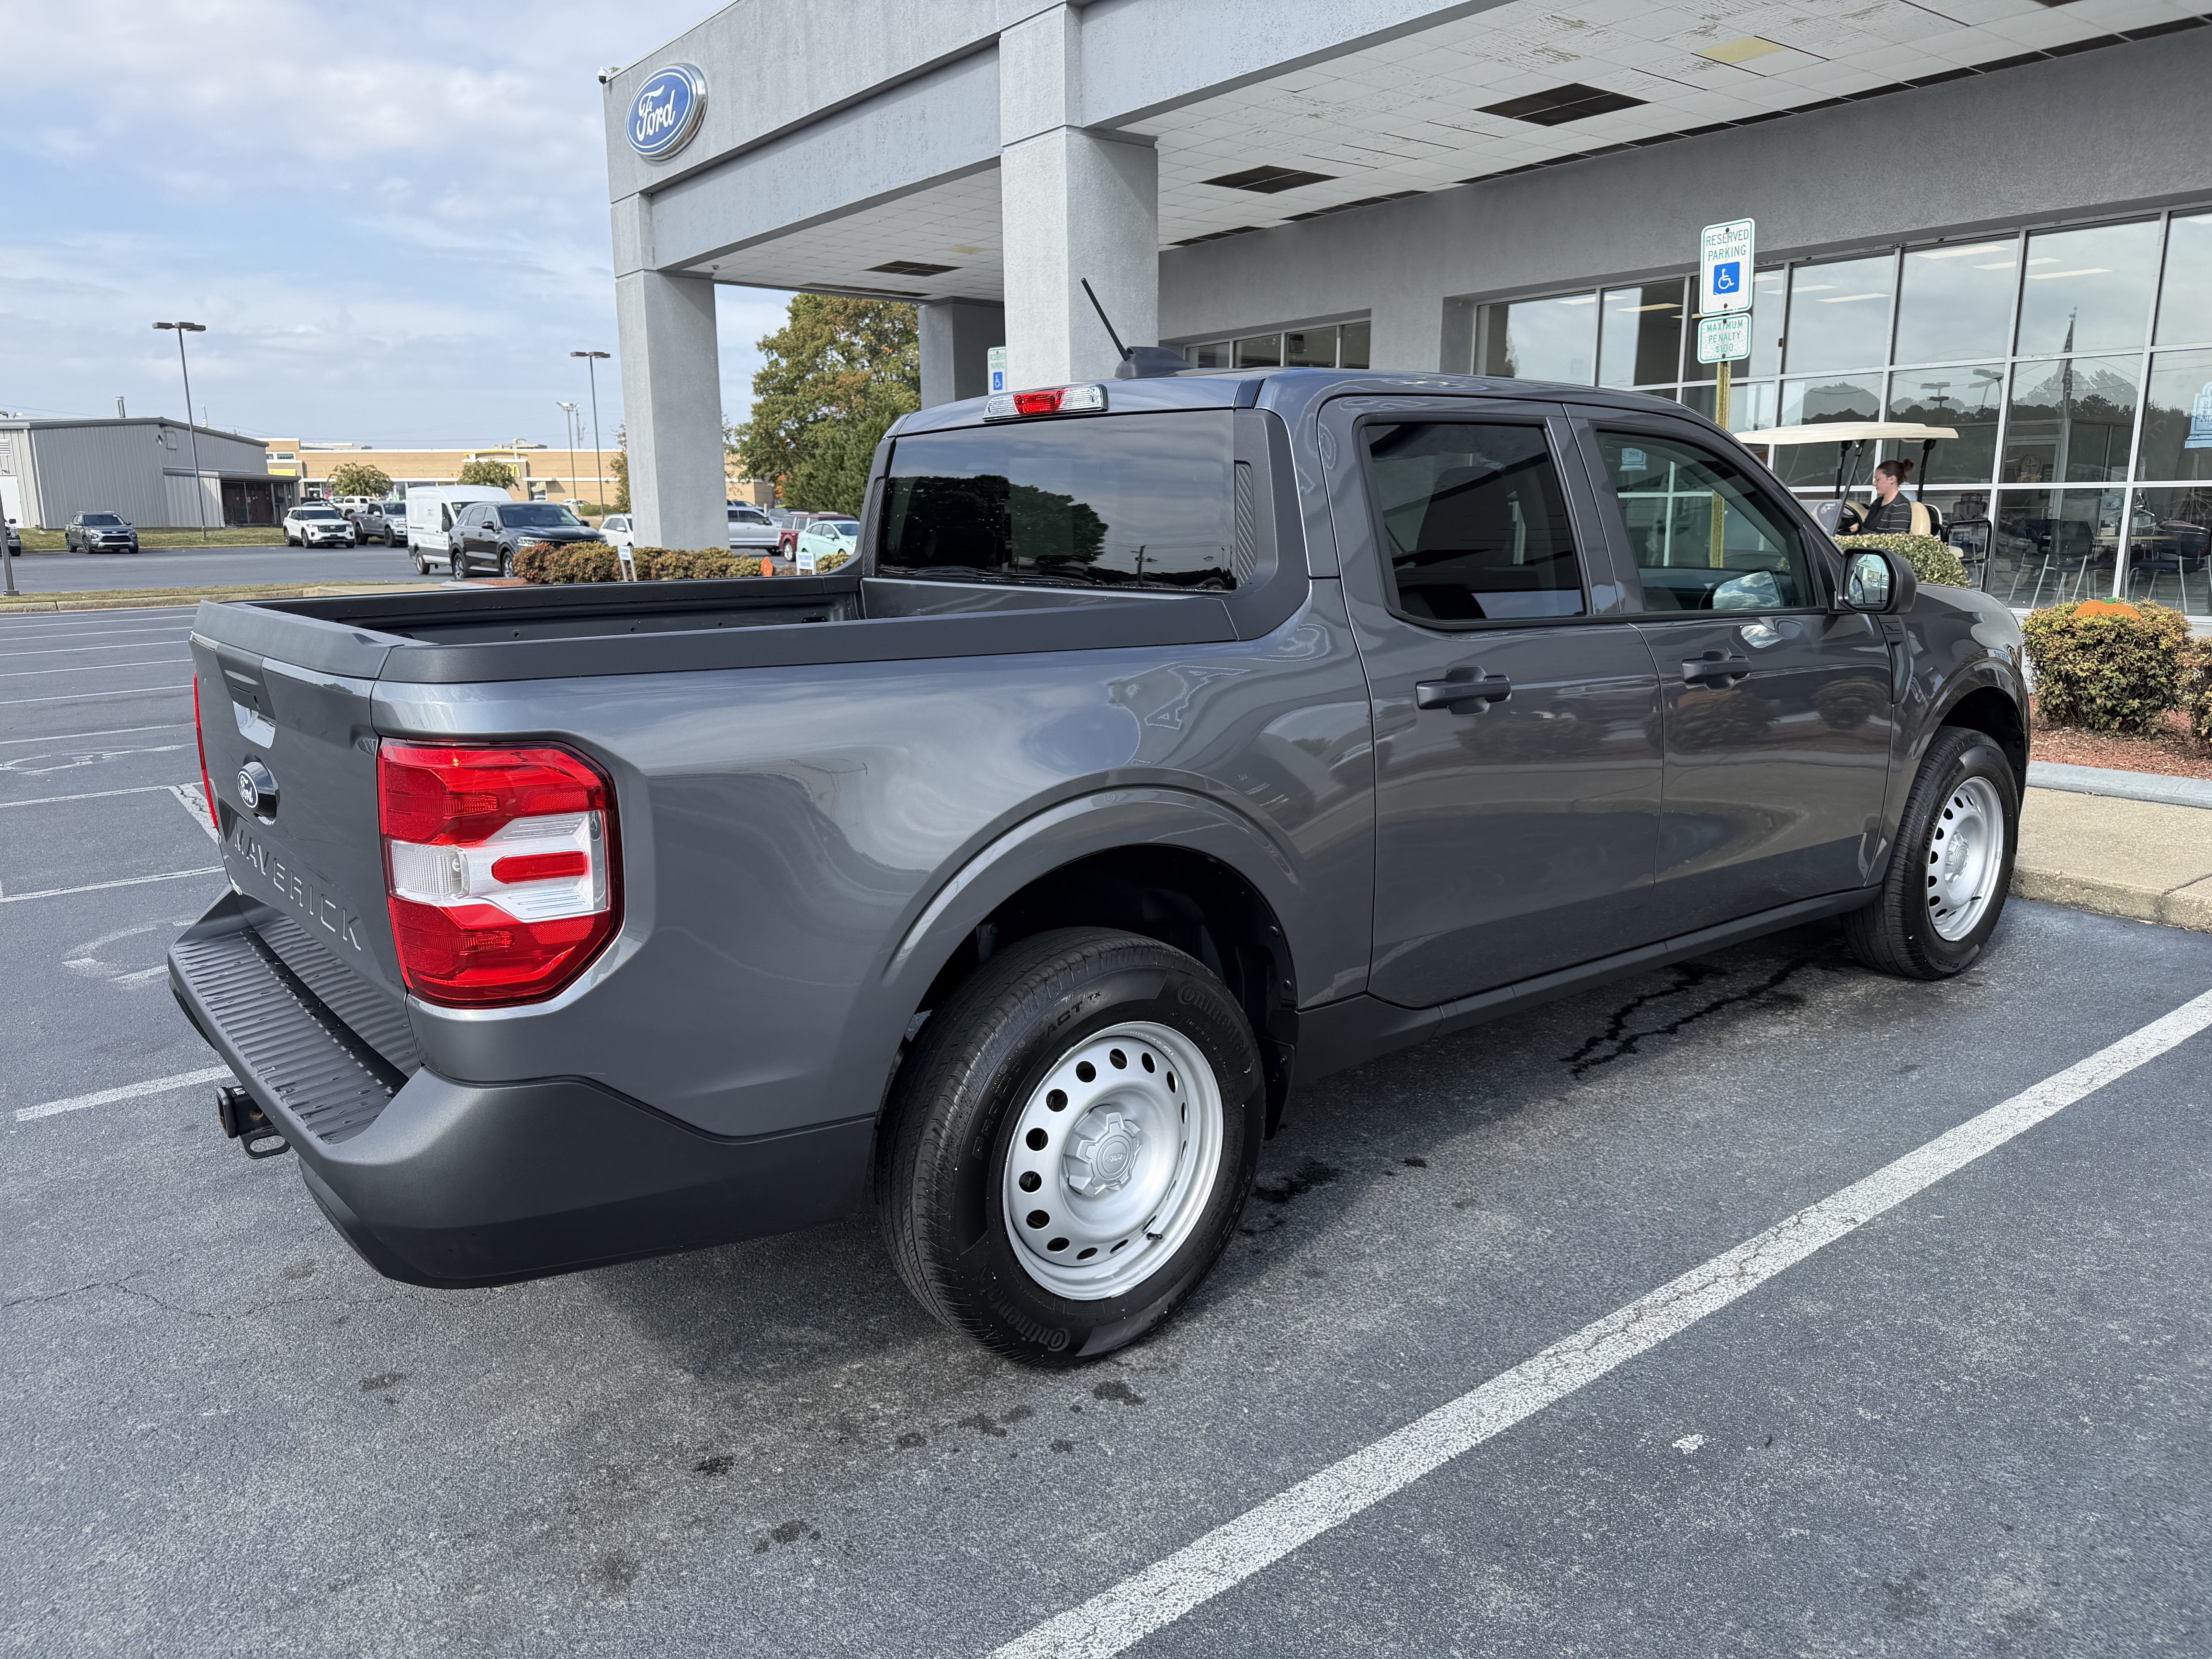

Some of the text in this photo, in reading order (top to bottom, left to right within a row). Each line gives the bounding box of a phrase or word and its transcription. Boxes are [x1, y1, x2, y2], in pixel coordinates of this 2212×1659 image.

[636, 85, 676, 141] Ford
[1706, 229, 1749, 246] RESERVED
[1708, 245, 1746, 261] PARKING
[1707, 319, 1743, 332] MAXIMUM
[1709, 331, 1741, 343] PENALTY
[240, 775, 253, 804] Ford
[234, 822, 362, 951] MAVERICK
